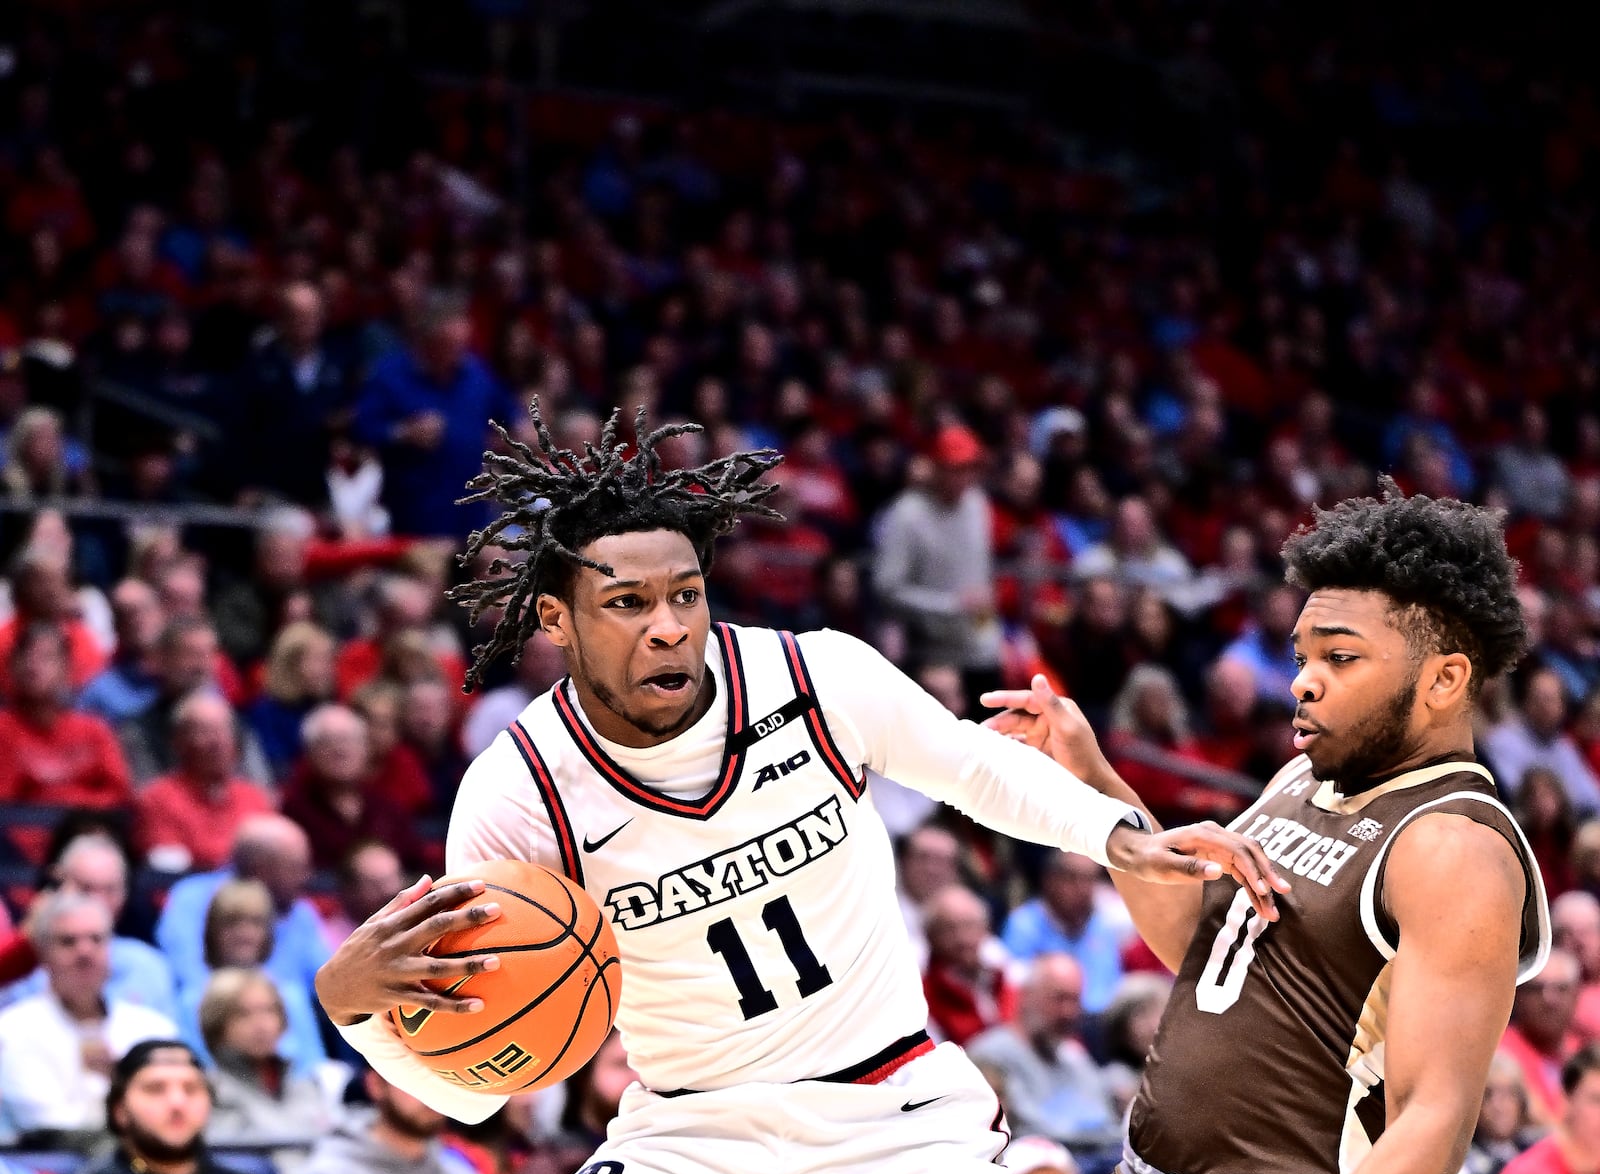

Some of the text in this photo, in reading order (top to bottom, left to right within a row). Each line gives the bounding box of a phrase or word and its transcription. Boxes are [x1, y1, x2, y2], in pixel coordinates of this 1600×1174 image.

[754, 712, 786, 739] DJD
[604, 794, 850, 931] DAYTON
[1242, 813, 1359, 887] LEHIGH
[706, 894, 834, 1021] 11
[1195, 886, 1270, 1015] 0
